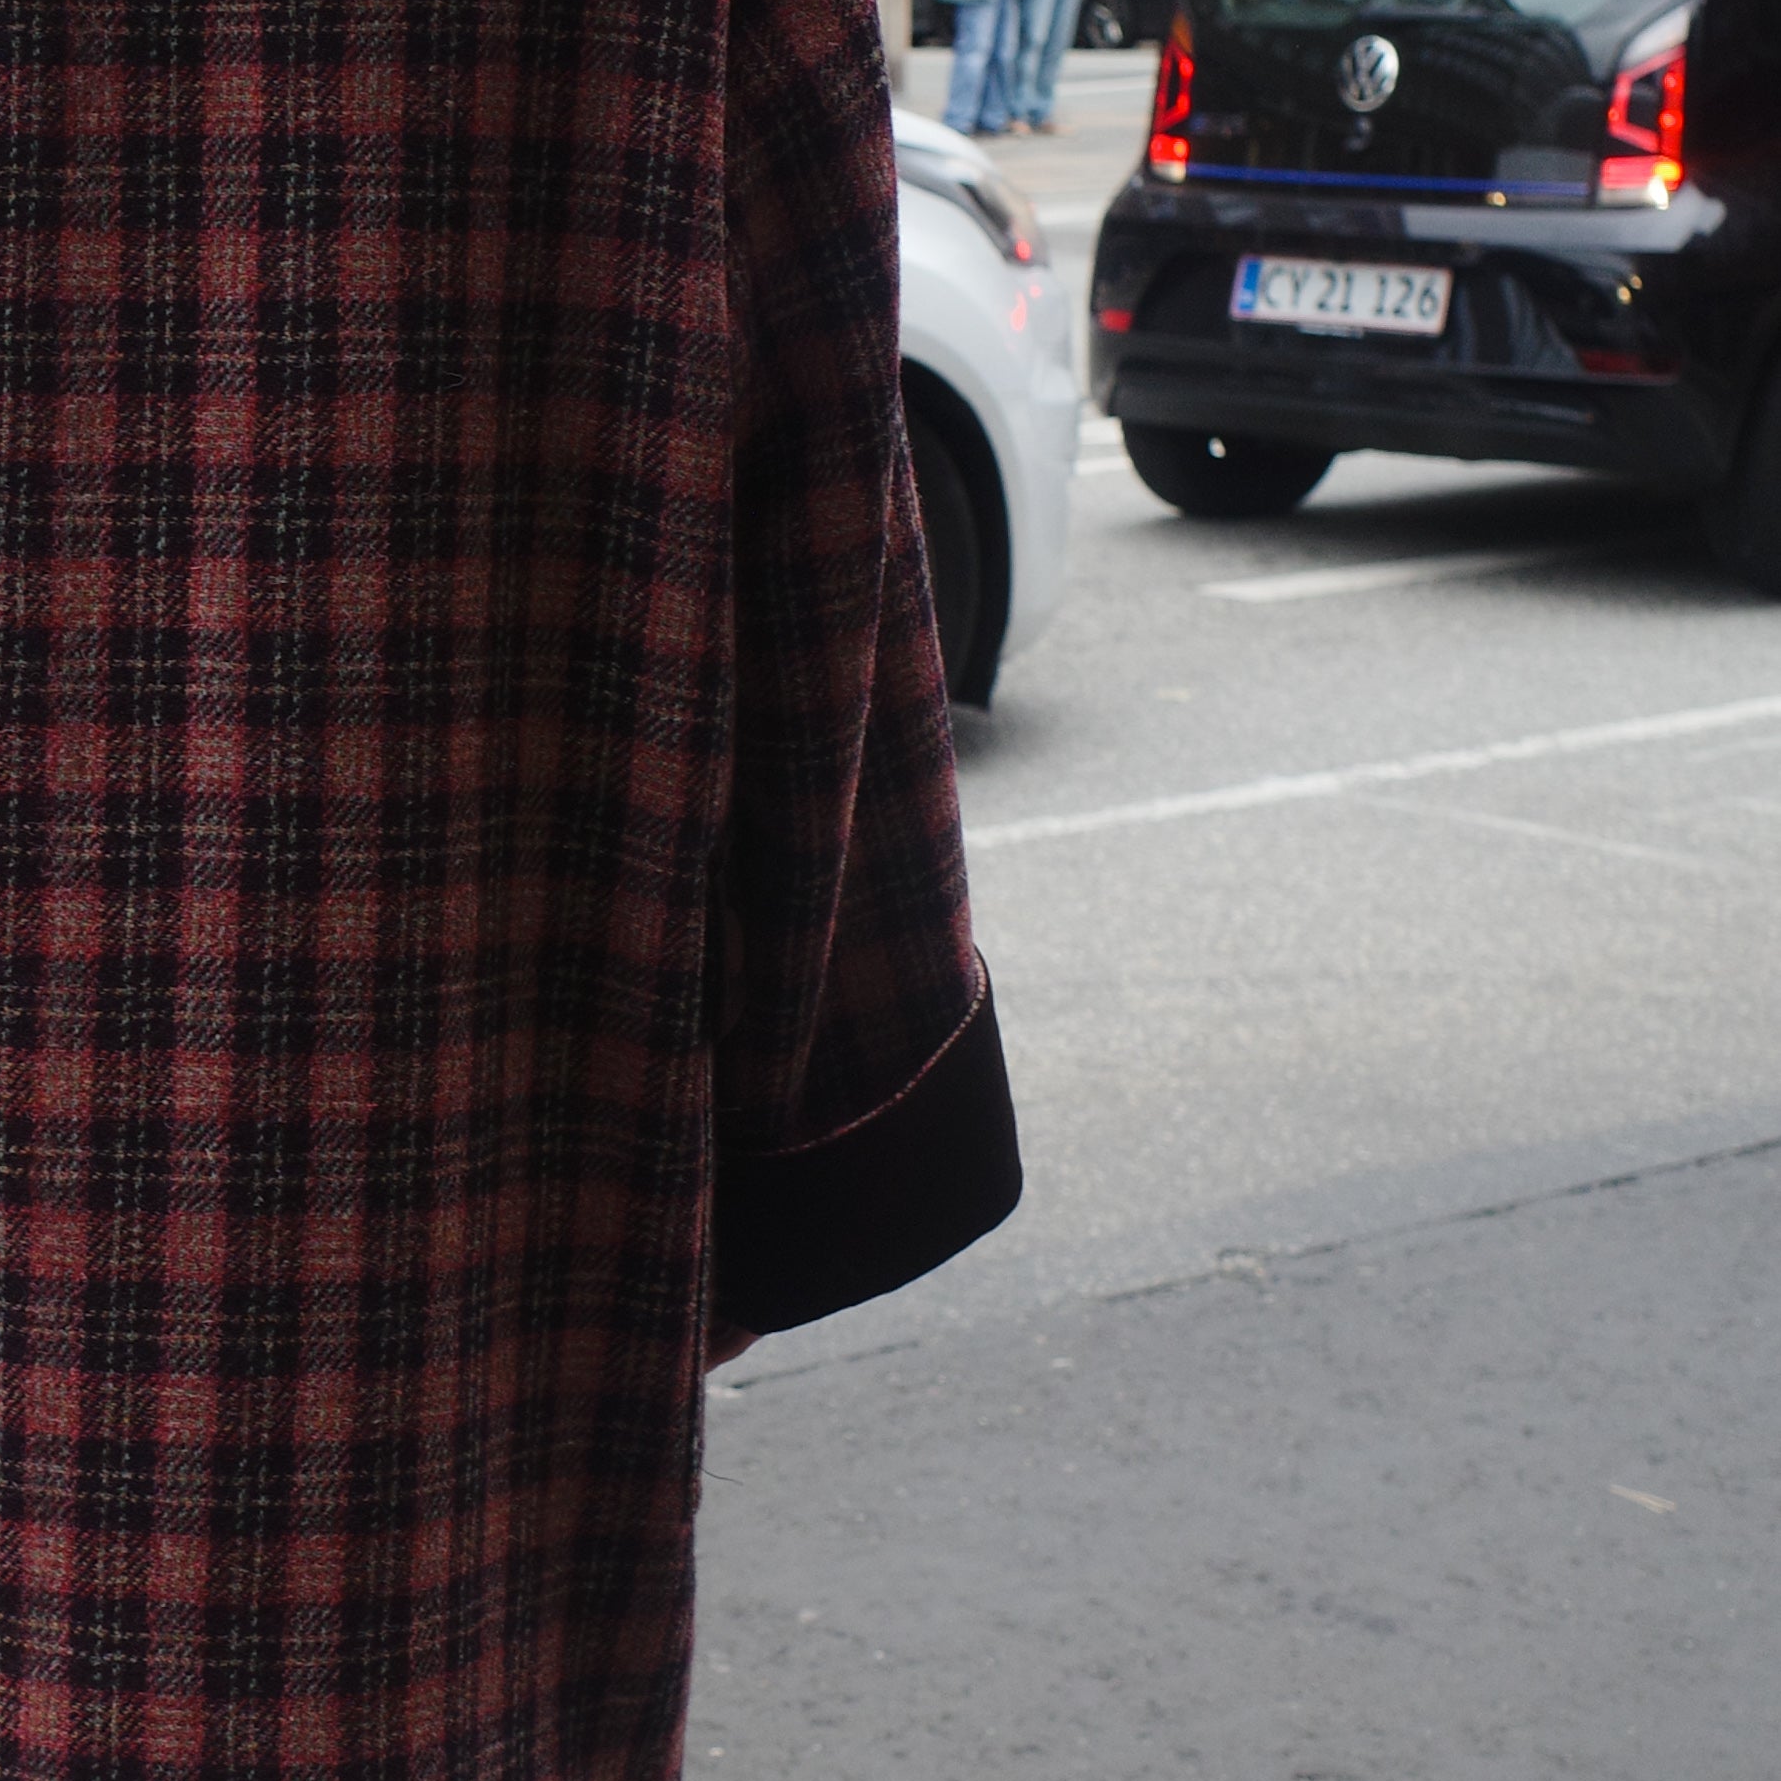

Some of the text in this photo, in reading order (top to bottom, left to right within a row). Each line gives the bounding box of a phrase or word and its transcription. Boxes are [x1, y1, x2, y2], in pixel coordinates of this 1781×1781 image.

[1264, 266, 1438, 321] CY 21 126
